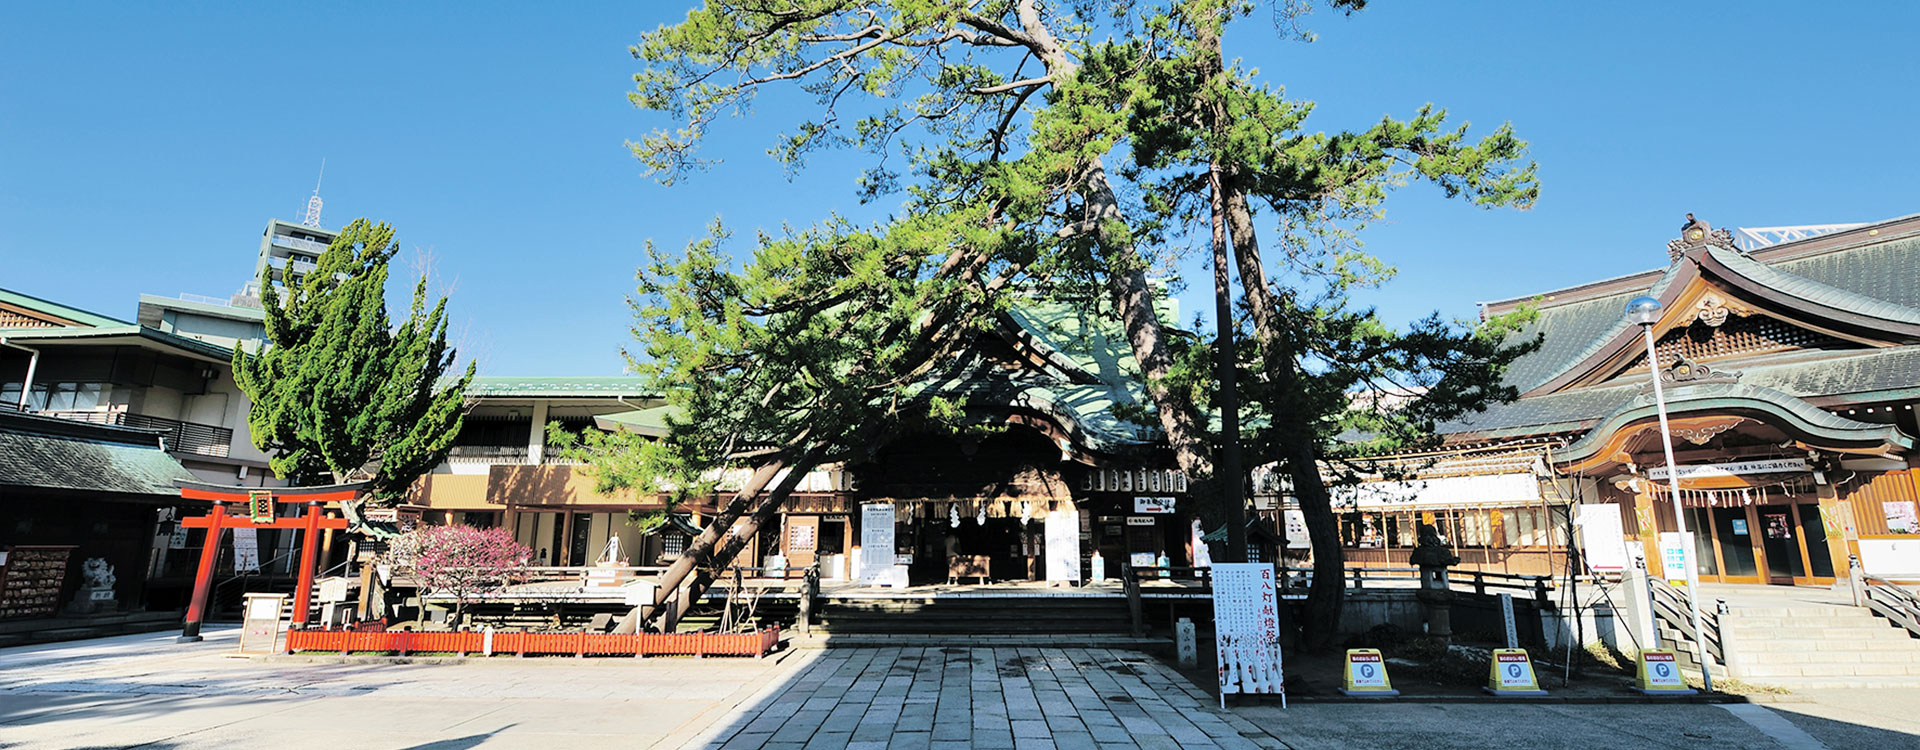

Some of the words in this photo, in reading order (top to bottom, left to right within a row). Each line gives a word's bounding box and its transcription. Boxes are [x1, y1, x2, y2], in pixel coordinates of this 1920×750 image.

[1260, 568, 1276, 643] 百八灯献燈祭
[1362, 665, 1373, 677] P
[1509, 665, 1520, 677] P
[1657, 664, 1669, 676] P
